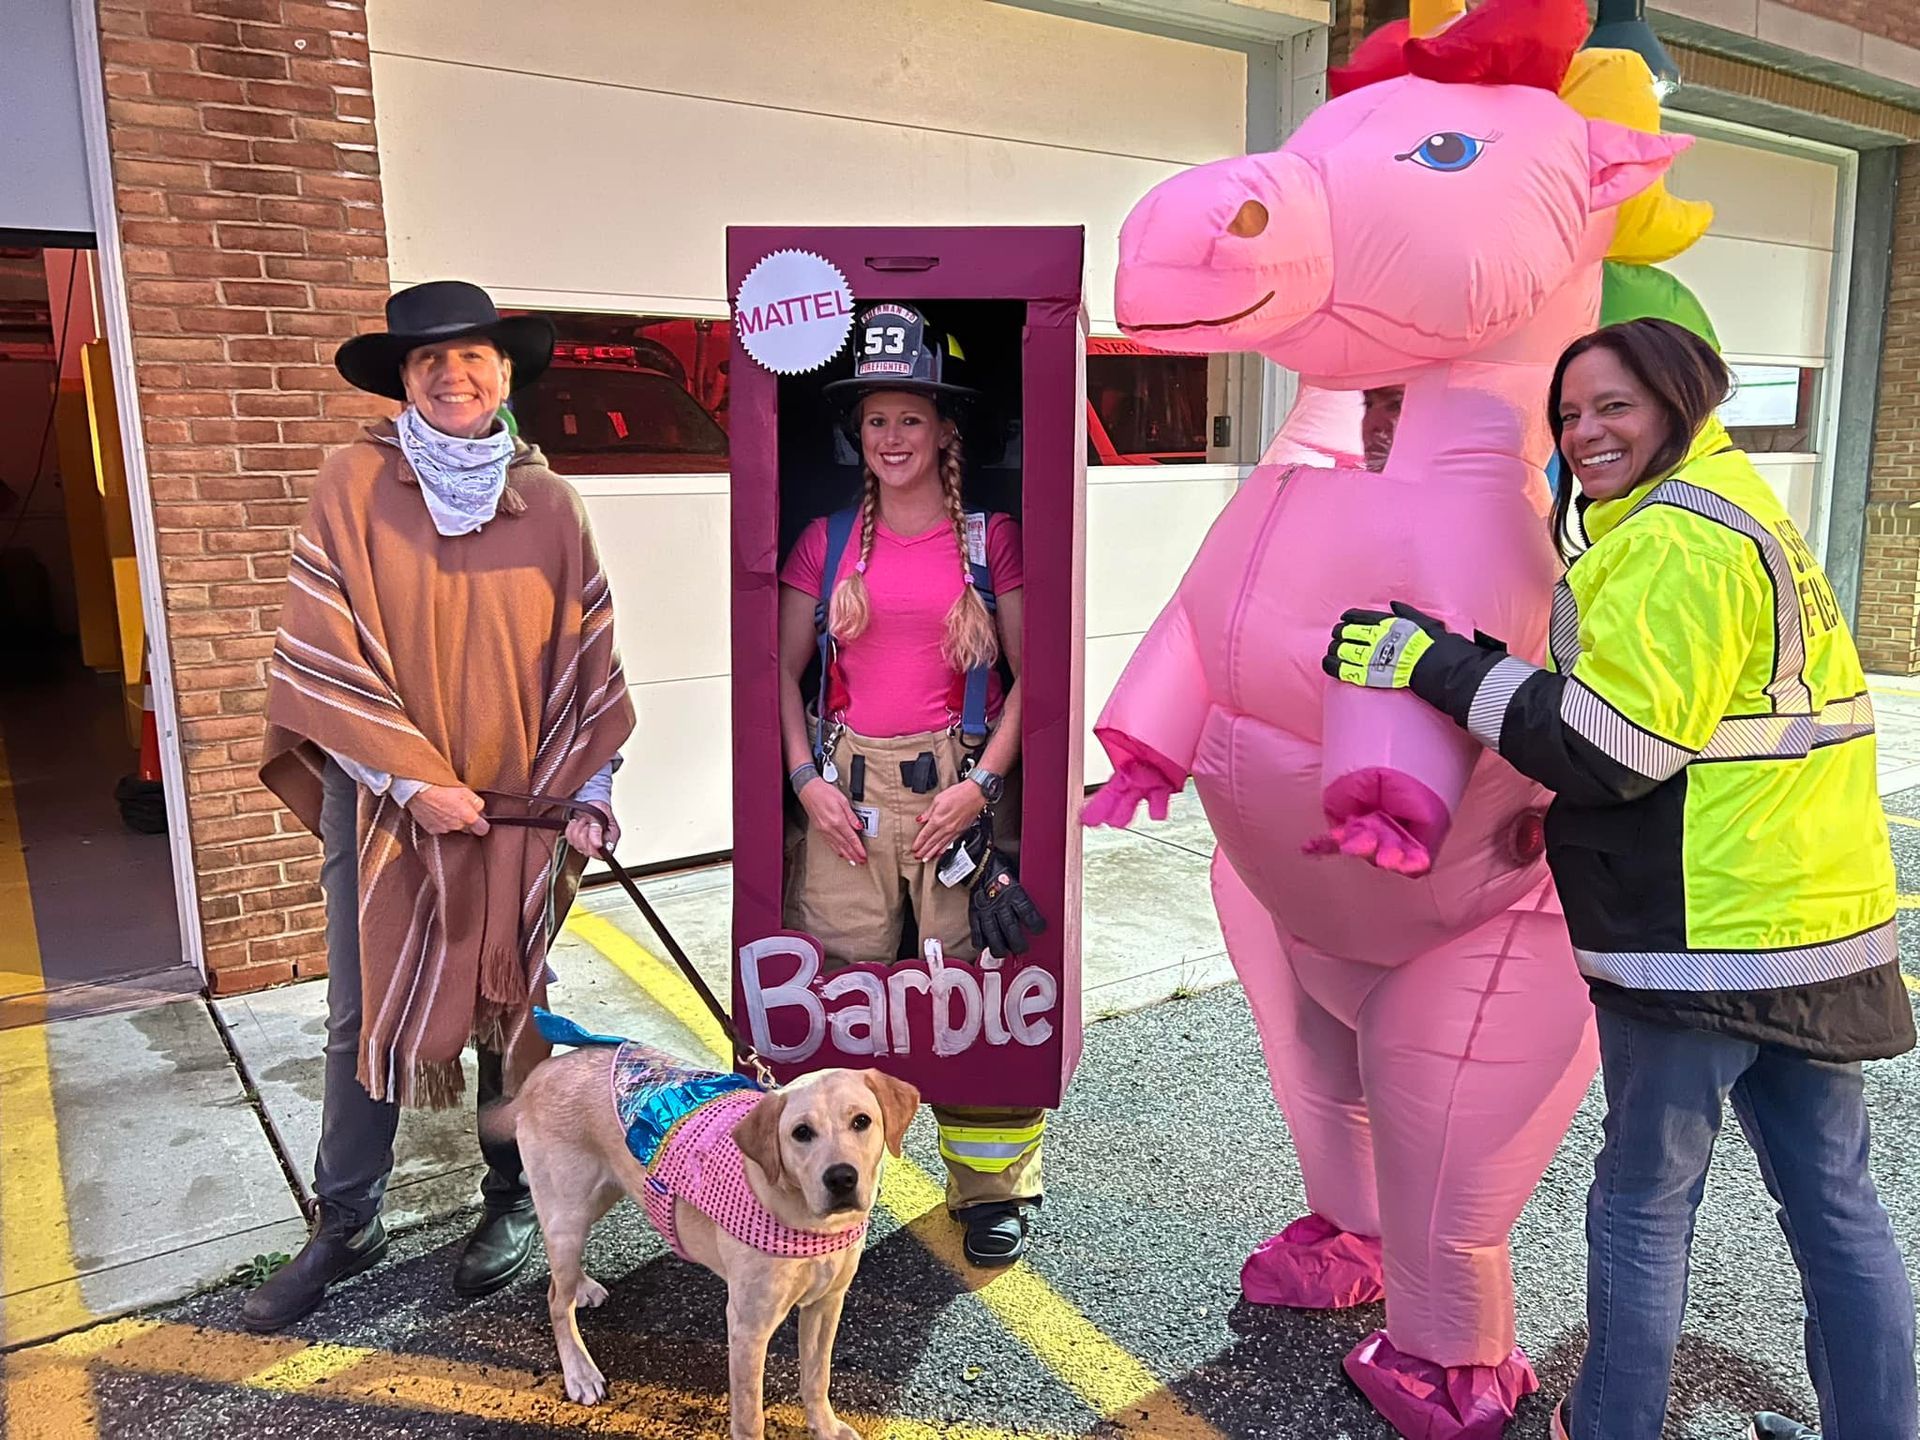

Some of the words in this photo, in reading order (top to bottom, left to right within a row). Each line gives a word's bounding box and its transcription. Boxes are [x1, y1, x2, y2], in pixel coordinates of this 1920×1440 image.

[738, 290, 850, 336] MATTEL
[864, 327, 905, 354] 53
[861, 362, 909, 374] FIREFIGHTER
[739, 937, 1057, 1063] Barbie
